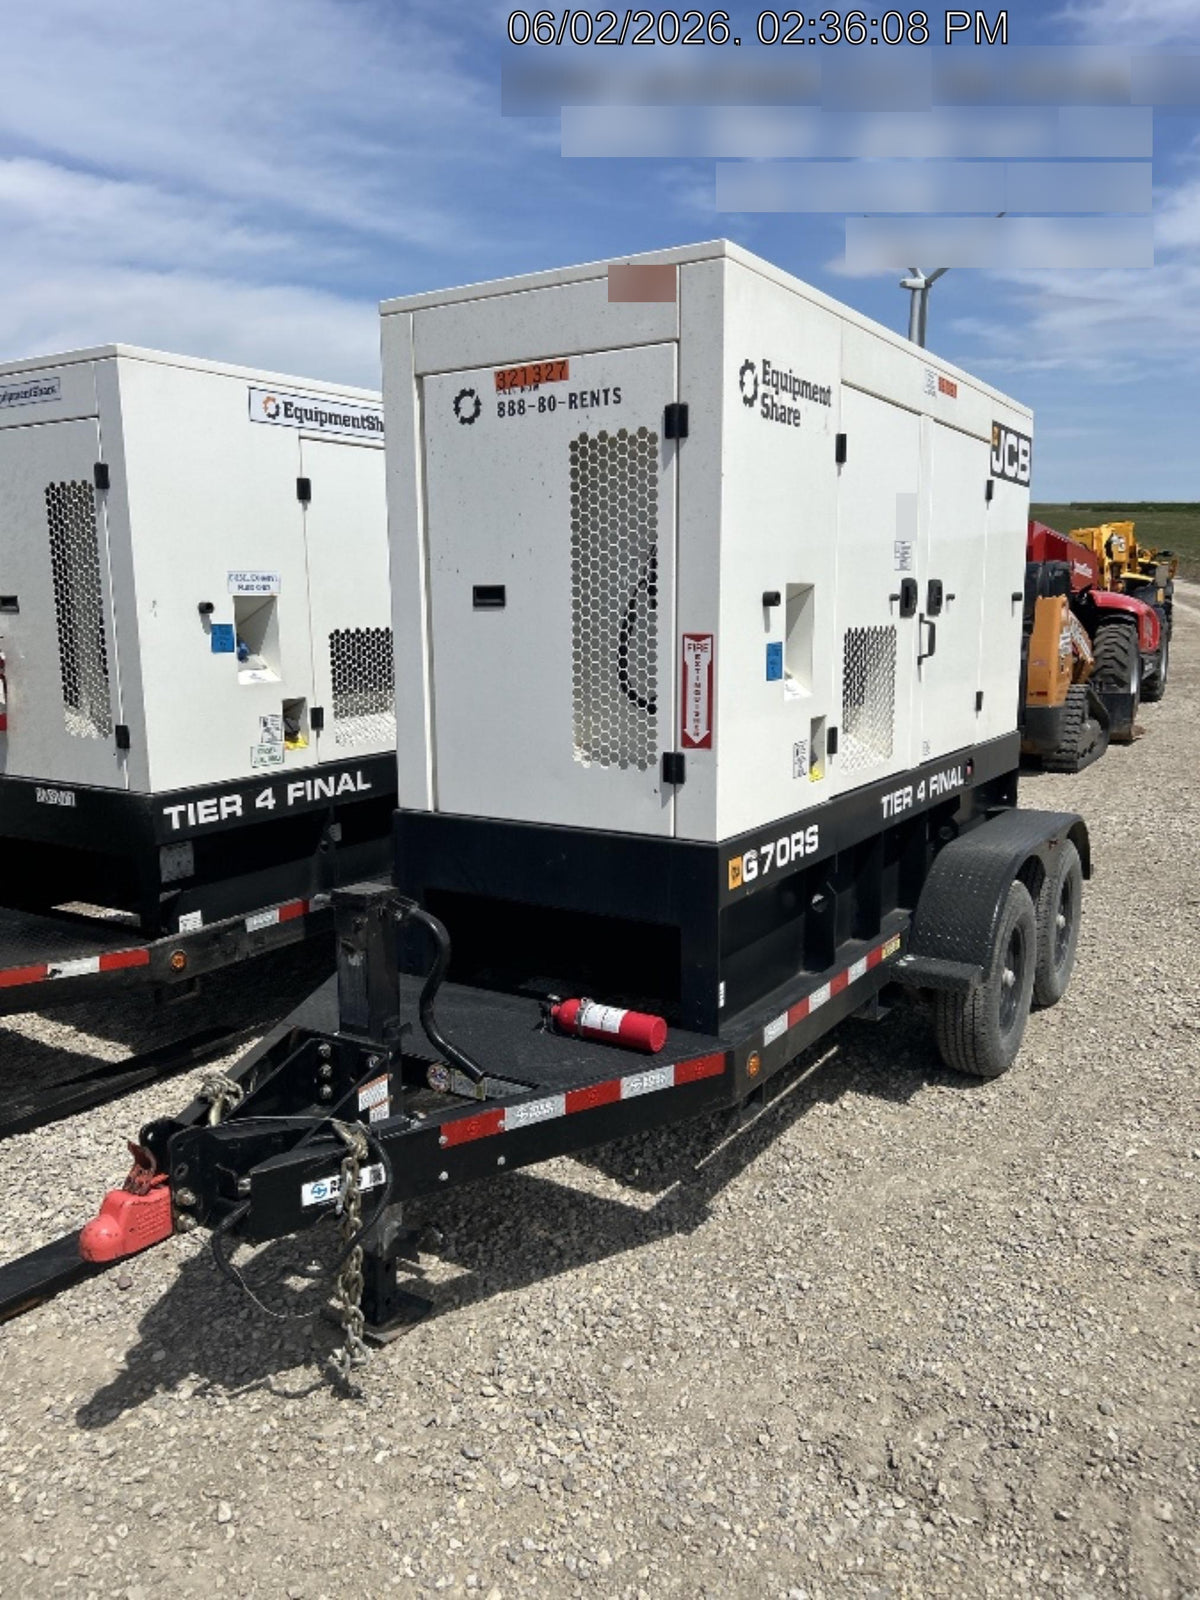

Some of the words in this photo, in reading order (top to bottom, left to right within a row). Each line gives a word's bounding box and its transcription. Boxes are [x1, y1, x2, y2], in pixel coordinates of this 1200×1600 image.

[496, 362, 567, 390] 321327
[762, 358, 832, 407] Equipment
[497, 387, 622, 418] 888-80-RENTS
[760, 392, 801, 427] Share
[991, 429, 1031, 482] JCB
[687, 642, 709, 653] FIRE
[163, 793, 243, 830] TIER
[255, 787, 276, 810] 4
[287, 770, 372, 807] FINAL
[880, 785, 913, 819] TIER
[917, 780, 925, 802] 4
[929, 765, 964, 799] FINAL
